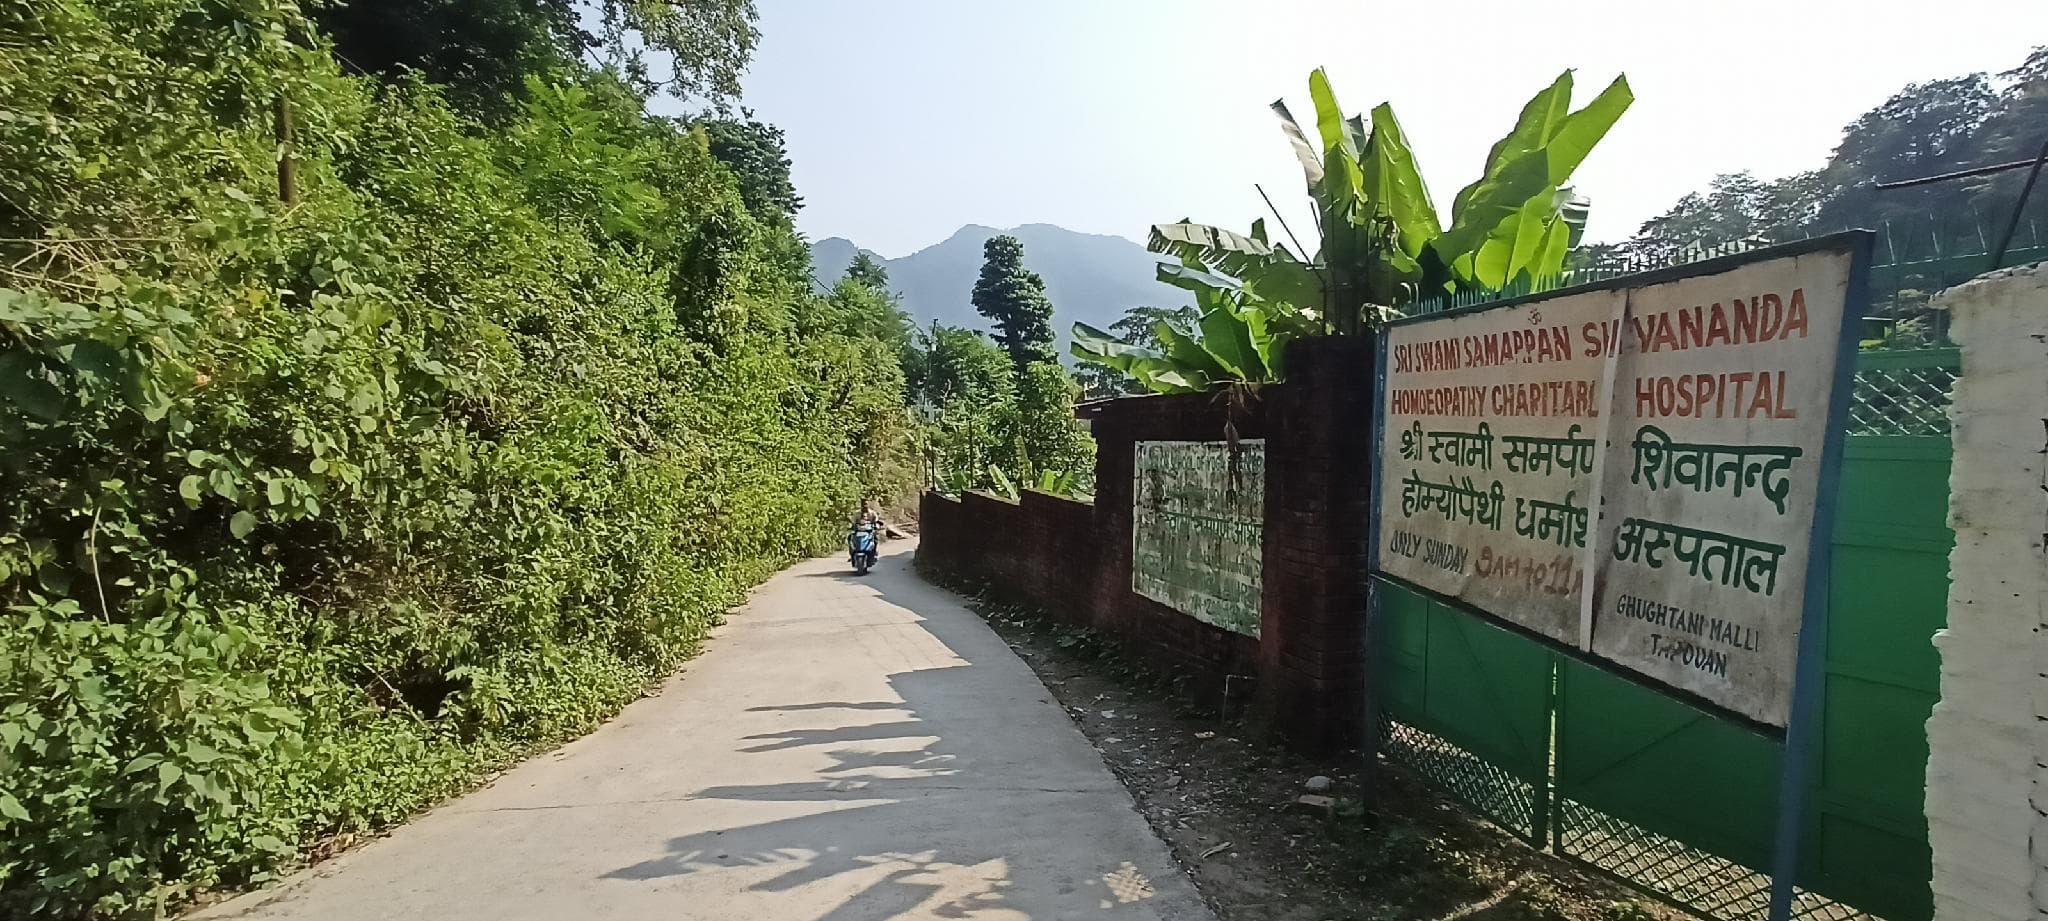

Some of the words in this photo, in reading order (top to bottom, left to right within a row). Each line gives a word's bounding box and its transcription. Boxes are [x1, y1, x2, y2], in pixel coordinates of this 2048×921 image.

[1394, 343, 1413, 374] SRI
[1415, 337, 1461, 373] SWAMI
[1391, 385, 1488, 418] HOMOEOPATHY
[1491, 379, 1600, 418] CHARITABL
[1635, 370, 1797, 419] HOSPITAL
[1399, 420, 1424, 462] श्री
[1427, 421, 1494, 472] स्वामी
[1630, 424, 1803, 515] शिवानन्द
[1390, 529, 1422, 559] ONLY
[1423, 538, 1469, 574] SUNDAY
[1612, 516, 1787, 597] अस्पताल
[1616, 594, 1705, 636] GHUGHTANI
[1709, 617, 1759, 652] MALLI
